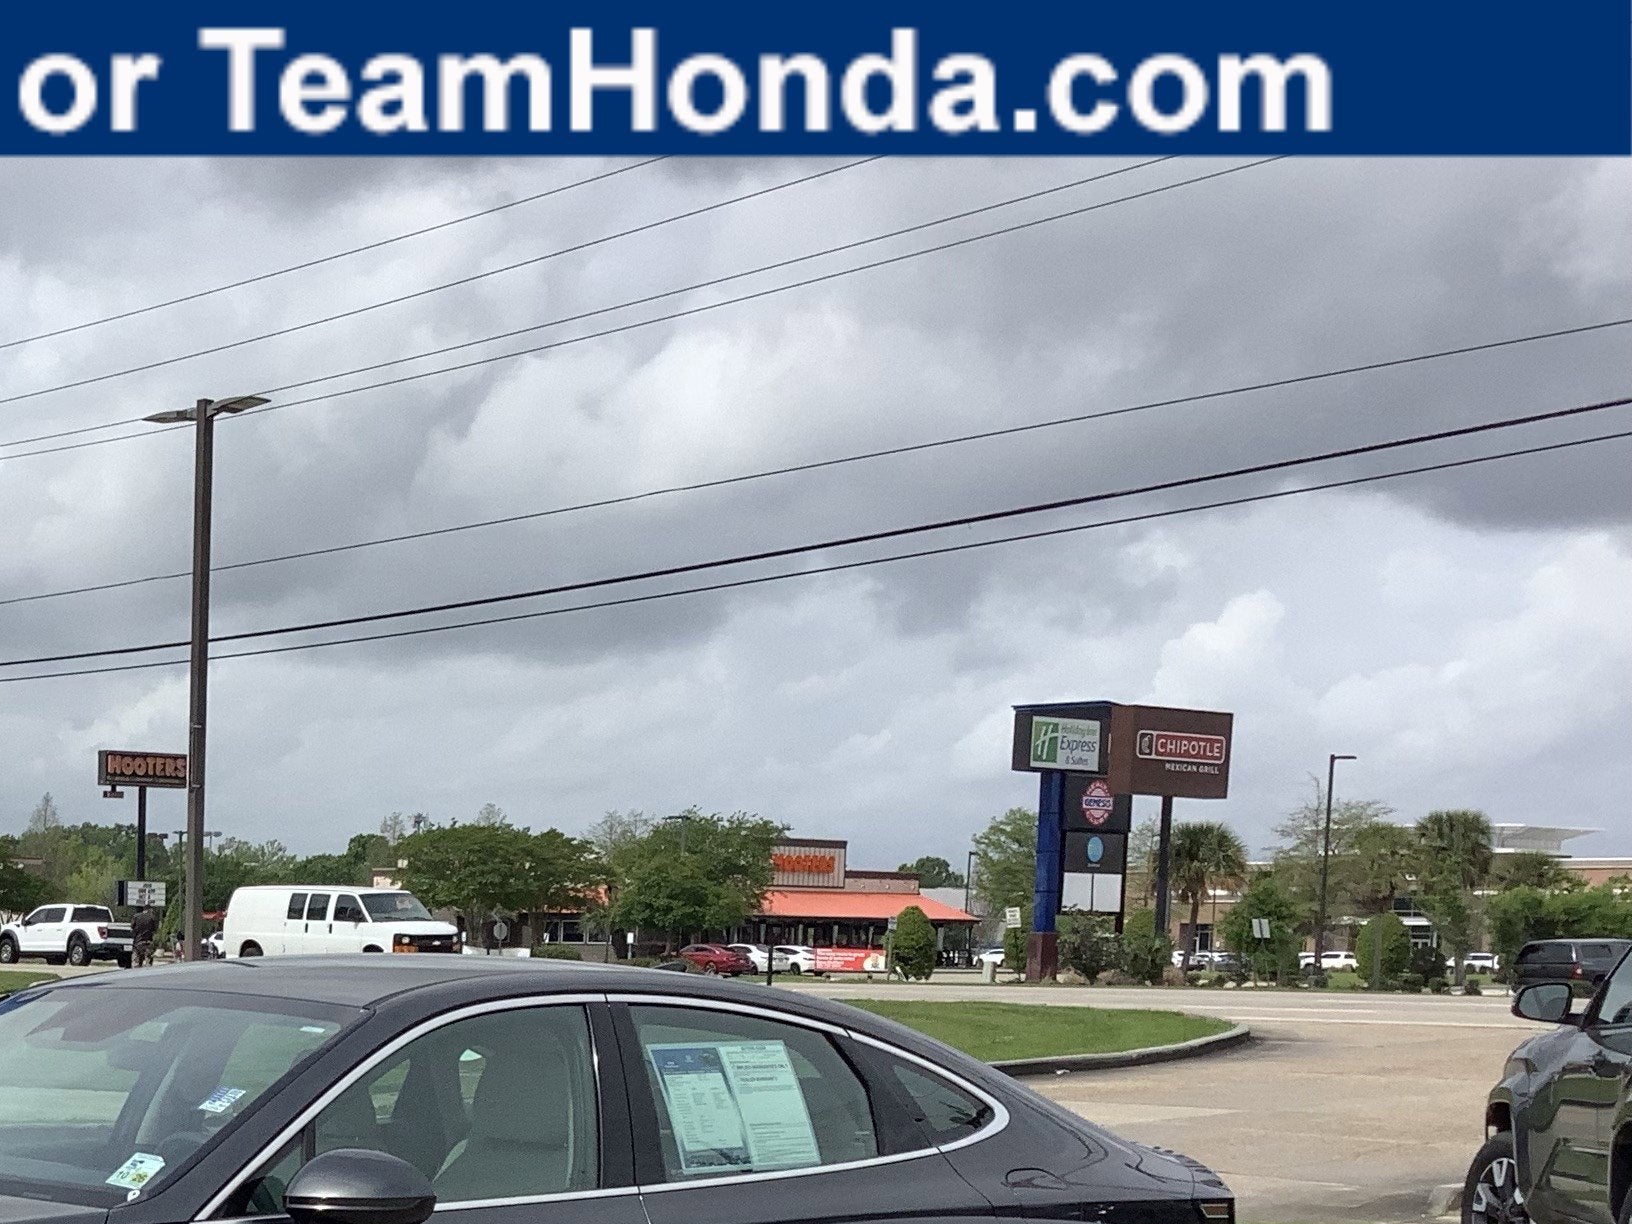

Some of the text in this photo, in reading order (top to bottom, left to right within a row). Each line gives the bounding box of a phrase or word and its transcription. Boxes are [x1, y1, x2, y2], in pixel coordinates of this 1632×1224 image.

[1059, 735, 1097, 754] Express
[1156, 738, 1222, 757] CHIPOTLE
[107, 754, 186, 778] HOOTERS
[1164, 762, 1219, 775] MEXICAN GRILL
